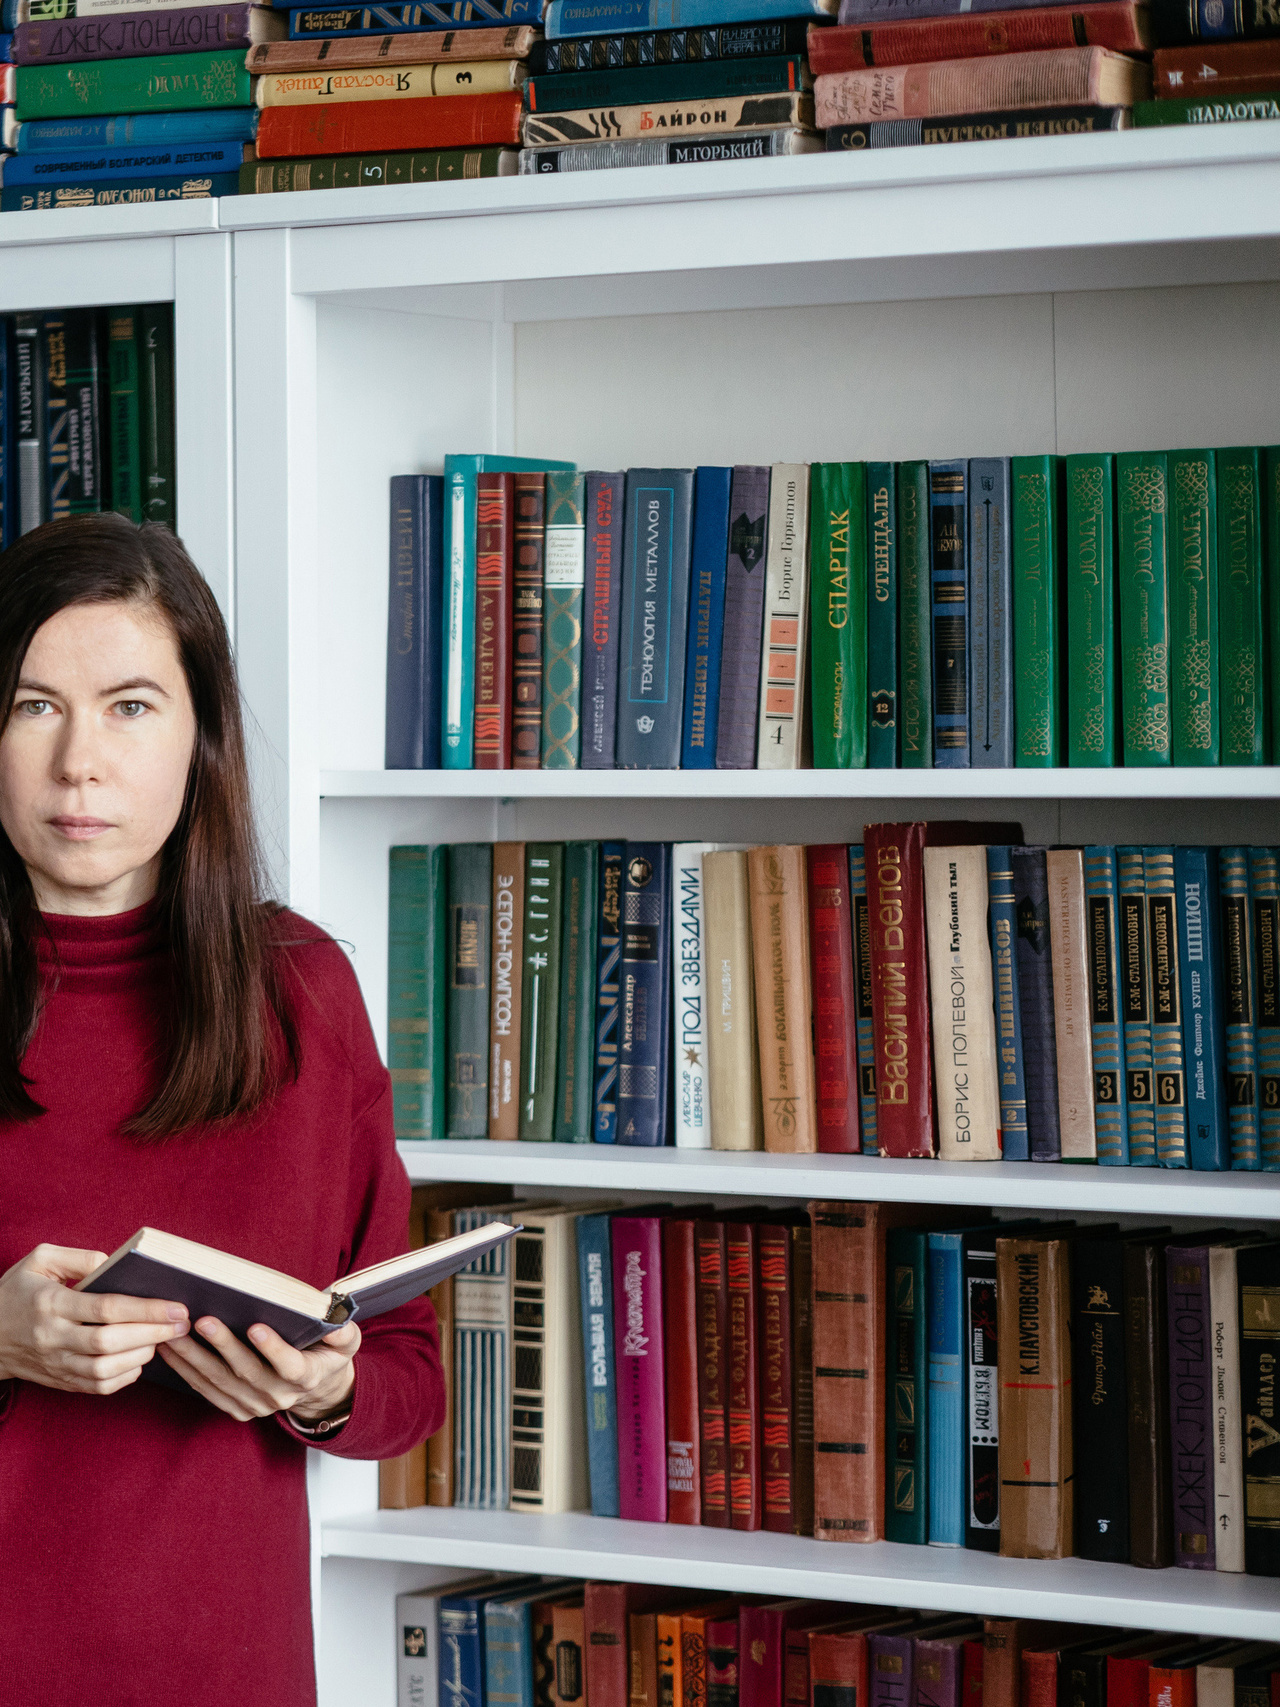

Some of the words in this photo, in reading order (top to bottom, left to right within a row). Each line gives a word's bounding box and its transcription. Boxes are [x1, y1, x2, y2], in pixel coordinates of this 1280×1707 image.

[47, 22, 113, 57] ДЖЕК
[119, 14, 220, 52] ЛОНДОН
[455, 71, 473, 85] 3
[639, 104, 728, 131] БАЙРОН
[924, 123, 1009, 145] РОЛЛАН
[1017, 116, 1095, 137] РОМЕН
[33, 155, 107, 174] СОВРЕМЕННЫЙ
[108, 151, 172, 169] БОЛГАРСКИЙ
[174, 149, 225, 166] ДЕТЕКТИВ
[364, 164, 383, 178] 5
[675, 138, 763, 164] М.ГОРЬКИЙ
[18, 343, 31, 433] М.ГОРЬКИЙ
[593, 488, 613, 527] СУД
[779, 480, 797, 552] Горбатов
[644, 499, 660, 593] МЕТАЛЛОВ
[828, 508, 850, 630] СПАРТАК
[873, 486, 893, 603] СТЕНДАЛЬ
[1078, 513, 1100, 586] ДЮМА
[1133, 511, 1156, 584] ДЮМА
[1181, 507, 1206, 583] ДЮМА
[591, 532, 612, 646] СТРАШНЫЙ
[778, 555, 793, 603] Борис
[697, 570, 713, 648] ПАТРИК
[479, 615, 495, 701] ФАДЕЕВ
[640, 600, 657, 695] ТЕХНОЛОГИЯ
[691, 654, 710, 748] КВЕНТИН
[875, 702, 889, 714] 12
[769, 724, 785, 746] 4
[529, 858, 551, 920] ГРИН
[876, 845, 906, 951] Белов
[947, 862, 958, 889] тыл
[680, 866, 701, 986] ЗВЕЗДАМИ
[948, 892, 962, 953] Глубокий
[1059, 875, 1071, 955] MASTERPIECES
[1184, 882, 1204, 962] ШПИОН
[495, 890, 514, 1036] СЕТОН-ТОМПСОН
[527, 951, 549, 970] А.
[721, 958, 732, 1016] ПРИШВИН
[1191, 970, 1202, 1009] КУПЕР
[622, 973, 637, 1052] Александр
[682, 995, 702, 1045] ПОД
[949, 965, 969, 1067] ПОЛЕВОЙ
[1062, 970, 1073, 1013] JEWISH
[877, 961, 910, 1106] Василий
[1065, 1016, 1073, 1037] ART
[1194, 1013, 1205, 1057] Фенимор
[953, 1073, 972, 1144] БОРИС
[1099, 1074, 1113, 1100] 3
[1132, 1073, 1147, 1099] 5
[1160, 1074, 1176, 1102] 6
[1195, 1060, 1207, 1100] Джеймс
[1233, 1076, 1248, 1100] 7
[1264, 1079, 1279, 1105] 8
[587, 1252, 604, 1307] ЗЕМЛЯ
[702, 1292, 721, 1380] ФАДЕЕВ
[731, 1296, 748, 1383] ФАДЕЕВ
[766, 1293, 784, 1382] ФАДЕЕВ
[1016, 1252, 1040, 1376] К.ПАУСТОВСКИЙ
[1091, 1322, 1104, 1355] Рабле
[1214, 1321, 1224, 1360] Роберт
[589, 1313, 608, 1387] БОЛЬШАЯ
[1174, 1291, 1206, 1435] ЛОНДОН
[1091, 1354, 1107, 1406] Франсуа
[1216, 1365, 1226, 1401] Льюис
[1217, 1406, 1227, 1465] Стивенсон
[1177, 1436, 1208, 1527] ДЖЕК
